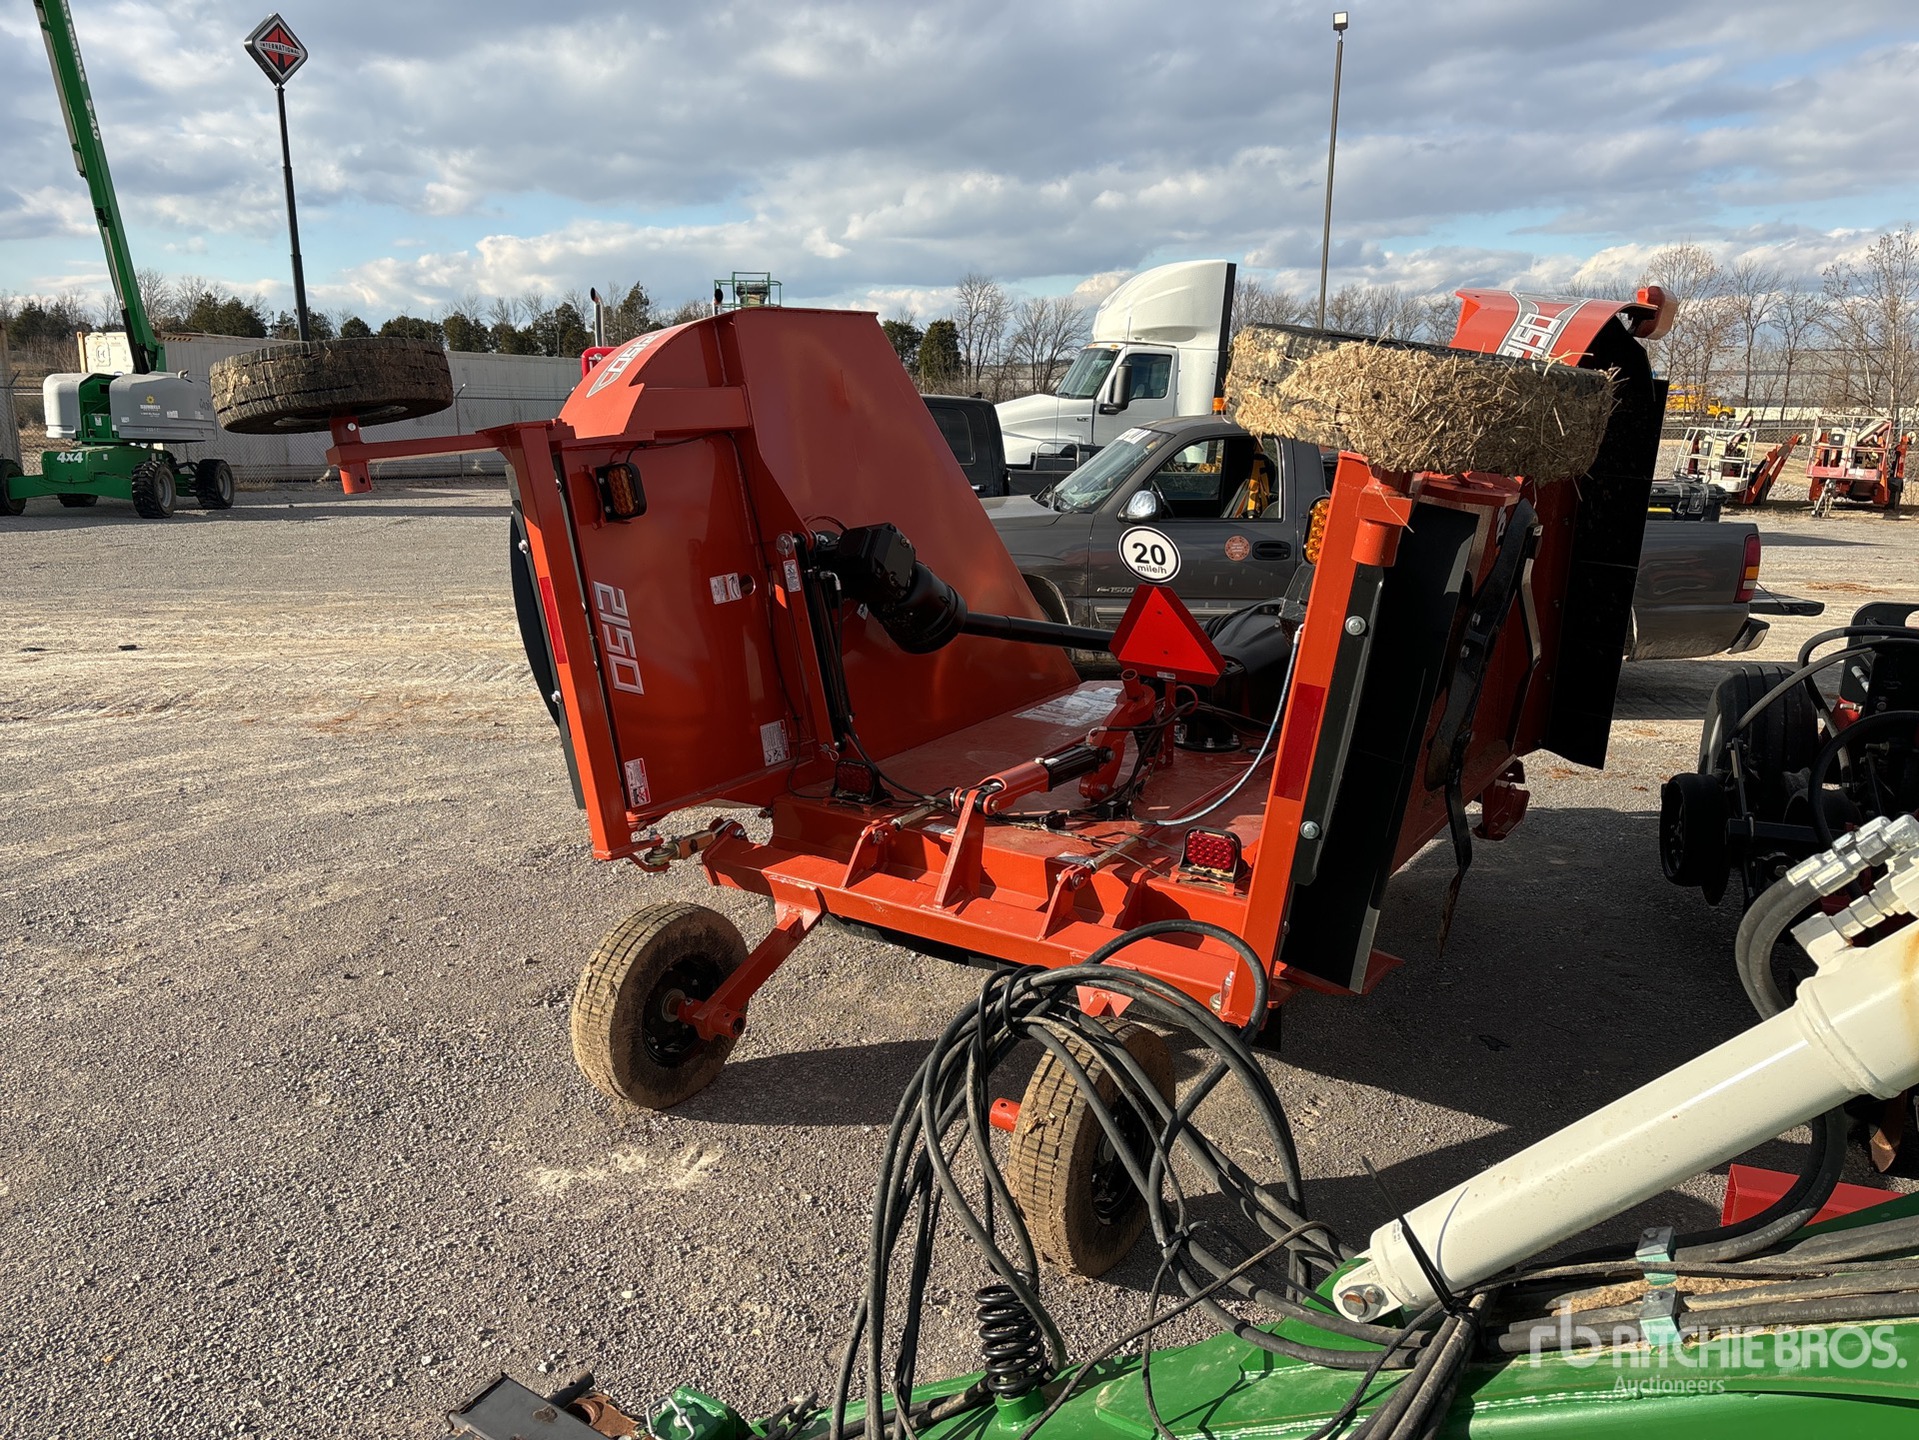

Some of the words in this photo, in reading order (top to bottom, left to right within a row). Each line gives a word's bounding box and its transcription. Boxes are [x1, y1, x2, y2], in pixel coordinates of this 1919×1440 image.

[259, 42, 302, 55] INTERNATIONAL
[56, 451, 84, 464] 4x4
[1132, 542, 1166, 566] 20
[1137, 565, 1168, 574] mile/h
[1110, 586, 1135, 594] 1500
[593, 581, 645, 695] 2150
